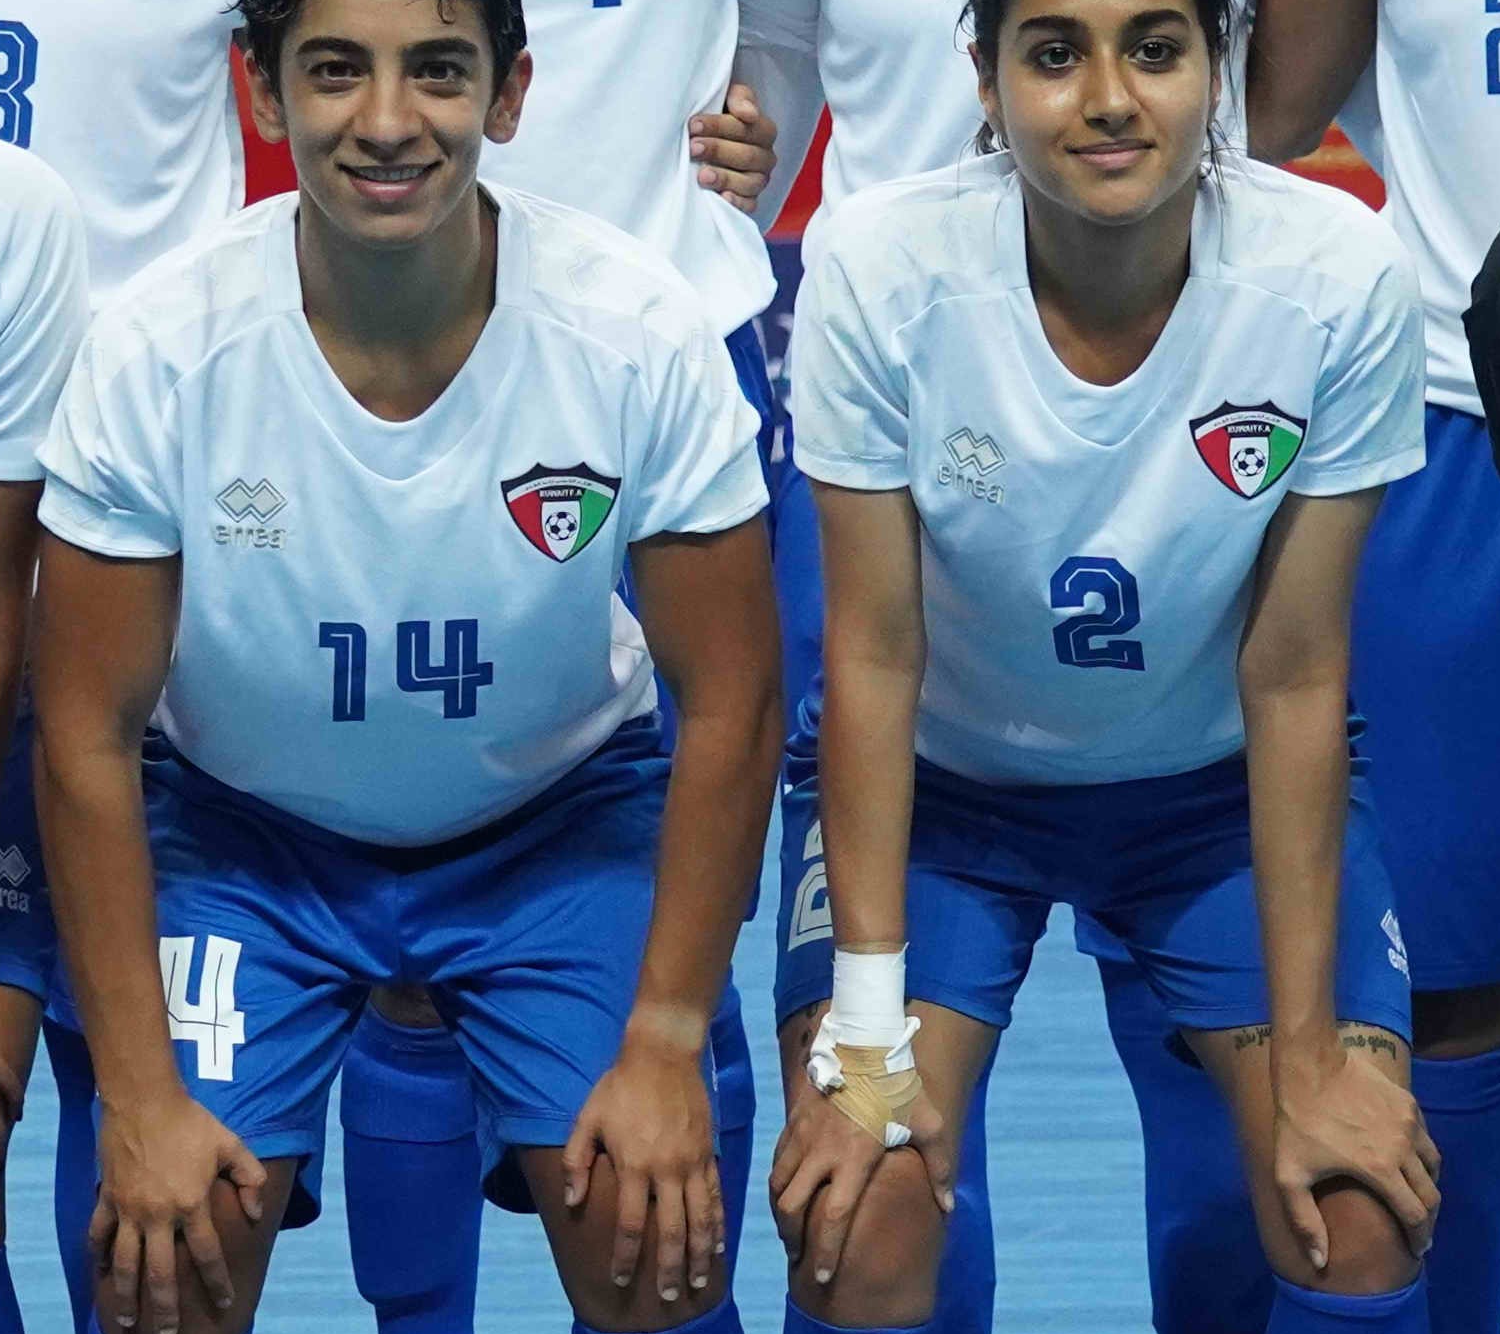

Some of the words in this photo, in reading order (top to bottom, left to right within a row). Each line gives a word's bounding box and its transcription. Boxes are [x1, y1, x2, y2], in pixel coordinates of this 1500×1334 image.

[318, 618, 494, 722] 14
[1049, 554, 1146, 672] 2
[158, 934, 246, 1082] 4
